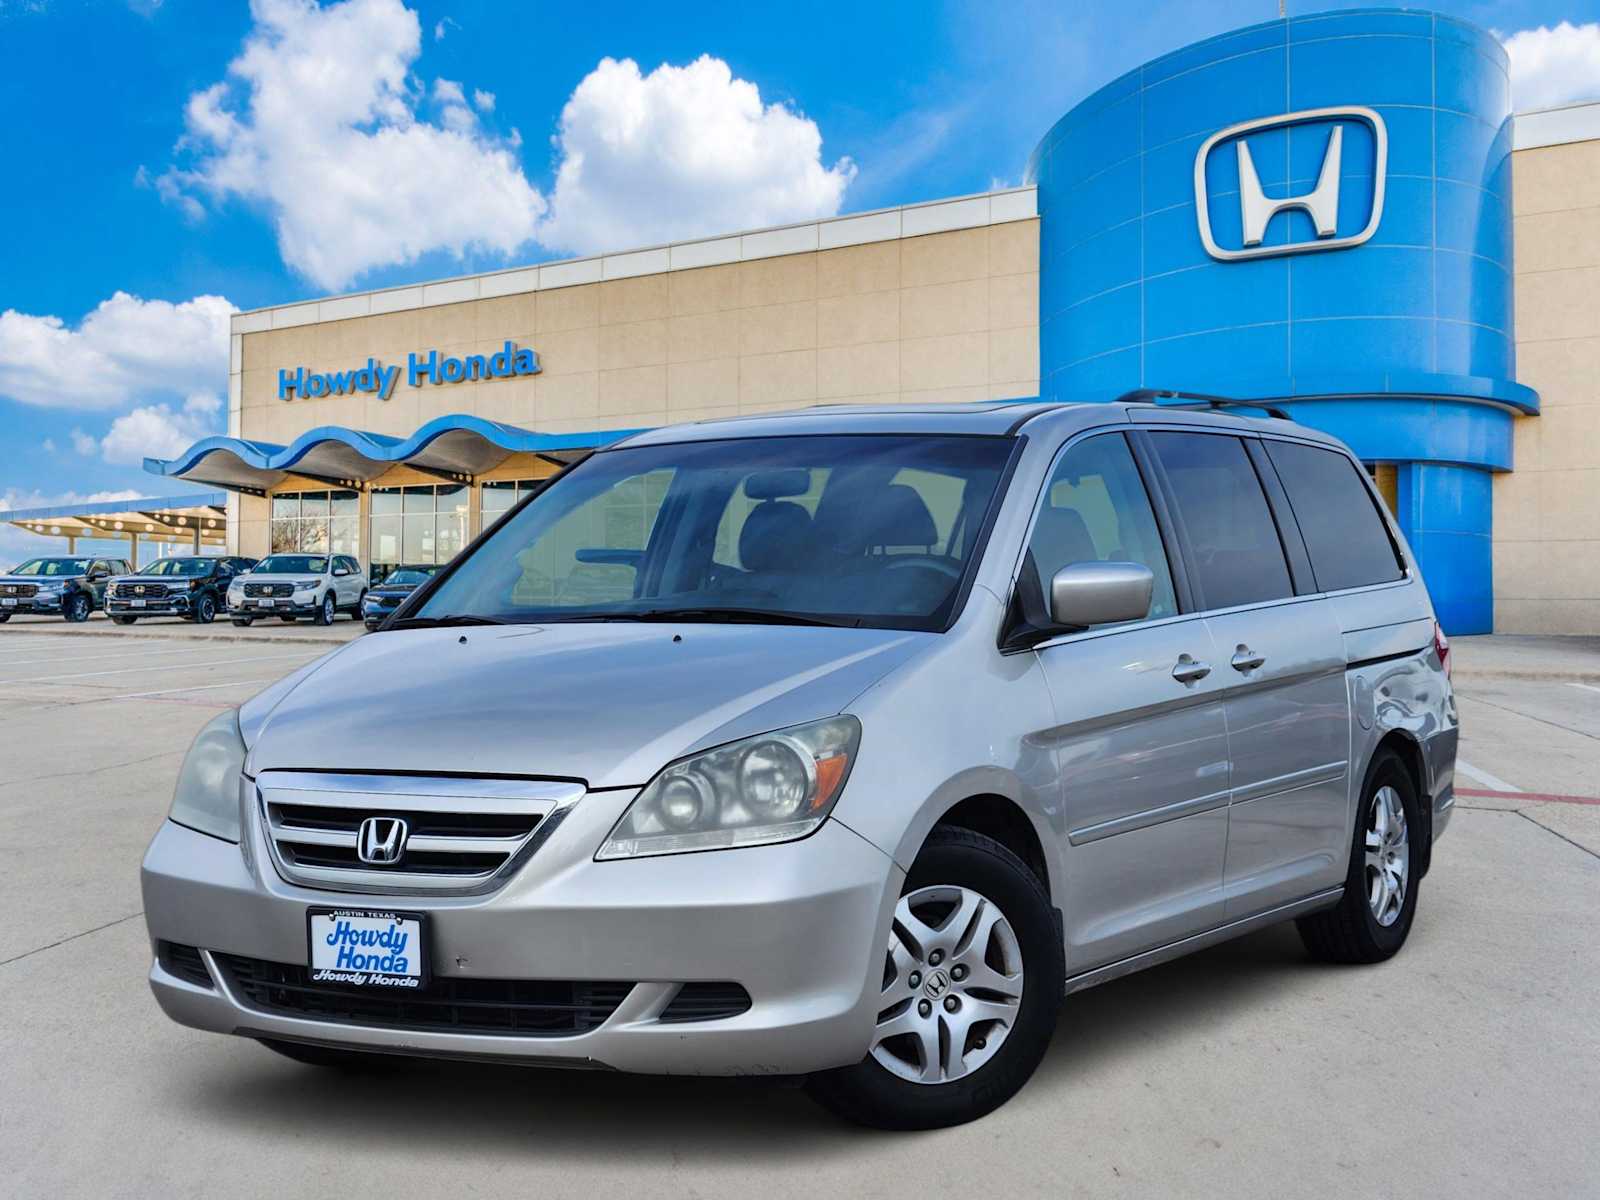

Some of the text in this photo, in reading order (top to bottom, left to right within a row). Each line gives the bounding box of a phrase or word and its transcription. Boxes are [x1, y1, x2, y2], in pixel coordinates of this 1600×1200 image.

[278, 341, 542, 400] Howdy Honda
[327, 921, 408, 955] Howdy
[336, 945, 408, 973] Honda
[313, 969, 419, 987] Howdy Honda
